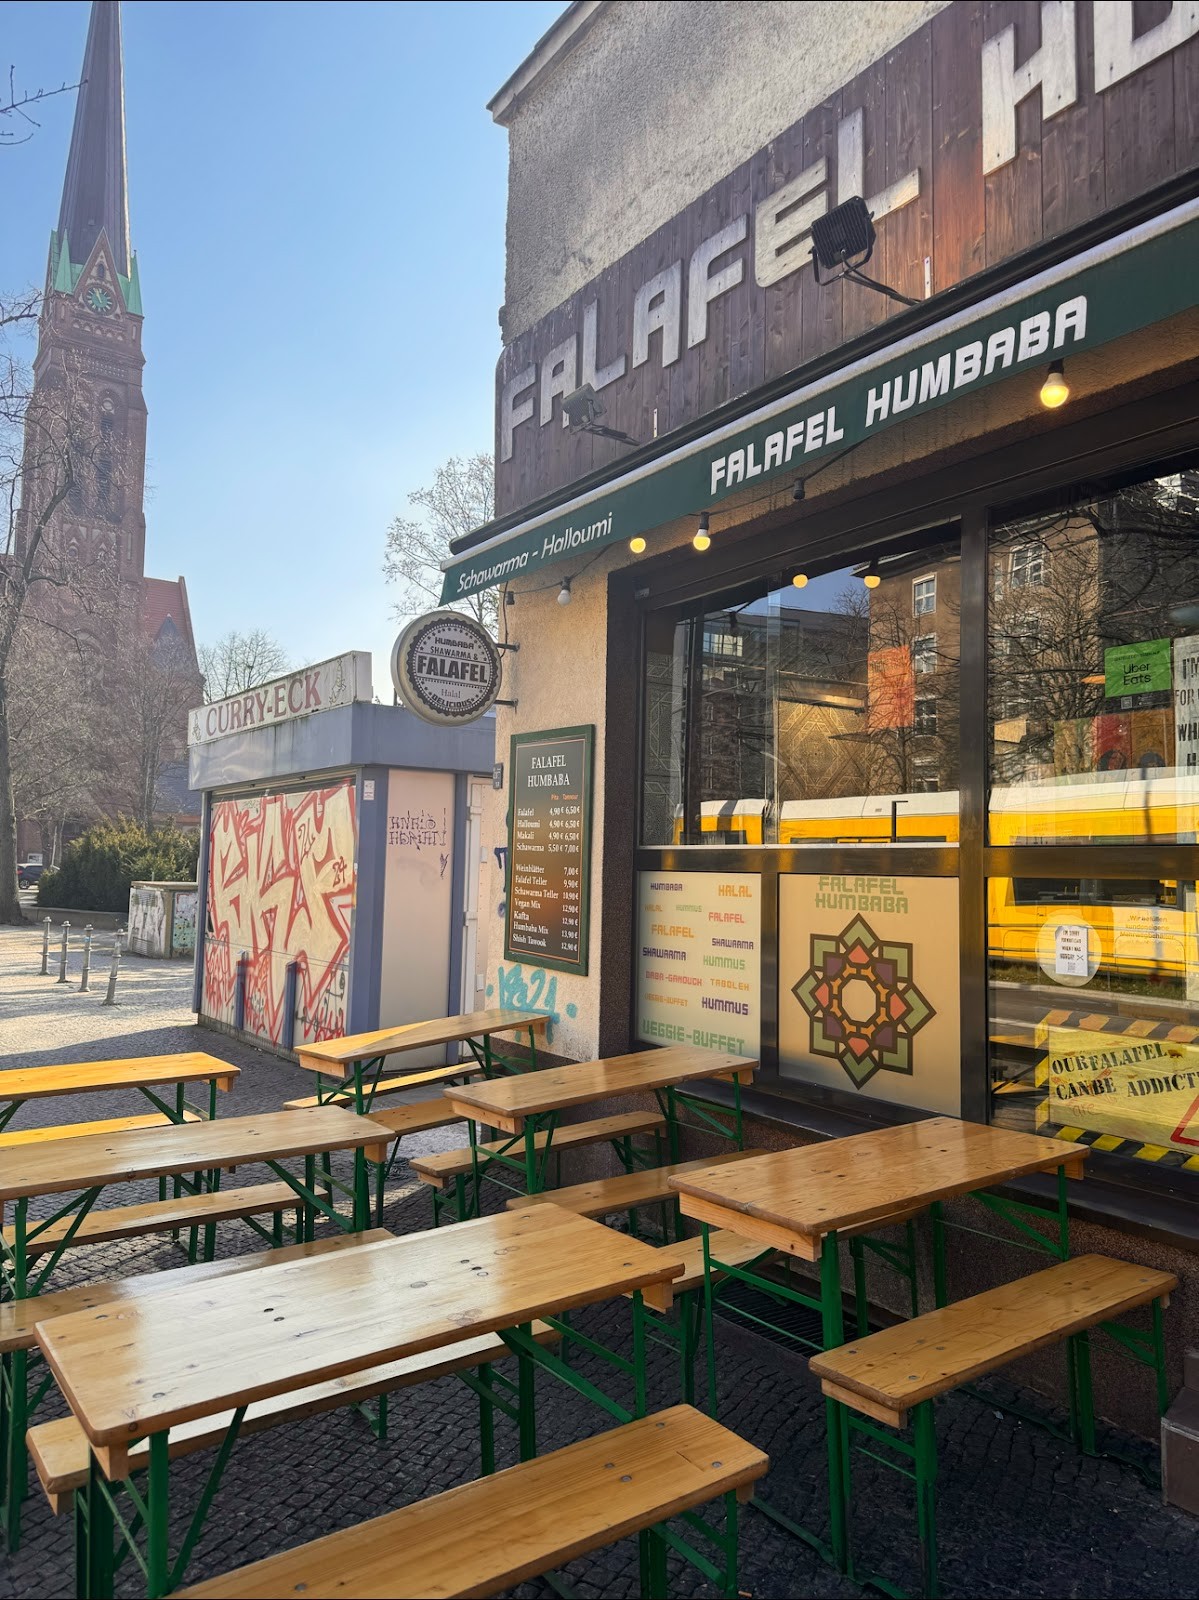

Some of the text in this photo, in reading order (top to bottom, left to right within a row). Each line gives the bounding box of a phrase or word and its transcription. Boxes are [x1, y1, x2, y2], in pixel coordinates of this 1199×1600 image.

[501, 106, 920, 463] FALAFEL
[711, 295, 1087, 495] FALAFEL HUMBABA
[457, 552, 529, 593] Schawarma
[541, 512, 613, 559] Halloumi
[434, 636, 475, 650] HUMBABA
[430, 646, 471, 660] SHAWARMA
[417, 655, 488, 683] FALAFEL
[1124, 664, 1150, 674] Uber
[1124, 674, 1151, 685] Eats
[206, 671, 322, 736] CURRY-ECK
[431, 694, 473, 708] DELICIOUS
[1178, 722, 1199, 742] WH
[531, 755, 566, 769] FALAFEL
[527, 773, 570, 787] HUMBABA
[517, 808, 534, 816] Falafel
[517, 820, 540, 828] Halloumi
[516, 842, 544, 852] Schawarma
[515, 875, 531, 884] Falafel
[532, 876, 547, 885] Teller
[650, 883, 682, 891] HUMBABA
[818, 876, 904, 895] FALAFEL
[514, 887, 542, 897] Schawarma
[543, 889, 558, 899] Teller
[718, 885, 752, 898] HALAL
[514, 898, 530, 908] Vegan
[531, 900, 540, 909] Mix
[815, 893, 908, 914] HUMBABA
[513, 910, 529, 920] Kafta
[708, 912, 745, 924] FALAFEL
[513, 921, 537, 932] Humbaba
[538, 925, 548, 934] Mix
[651, 924, 694, 938] FALAFEL
[512, 933, 526, 943] Shish
[528, 935, 546, 947] Tawook
[712, 938, 754, 950] SHAWARMA
[642, 947, 686, 961] SHAWARMA
[703, 955, 745, 970] HUMMUS
[702, 997, 749, 1015] HUMMUS
[642, 1019, 745, 1055] VEGGIE-BUFFET
